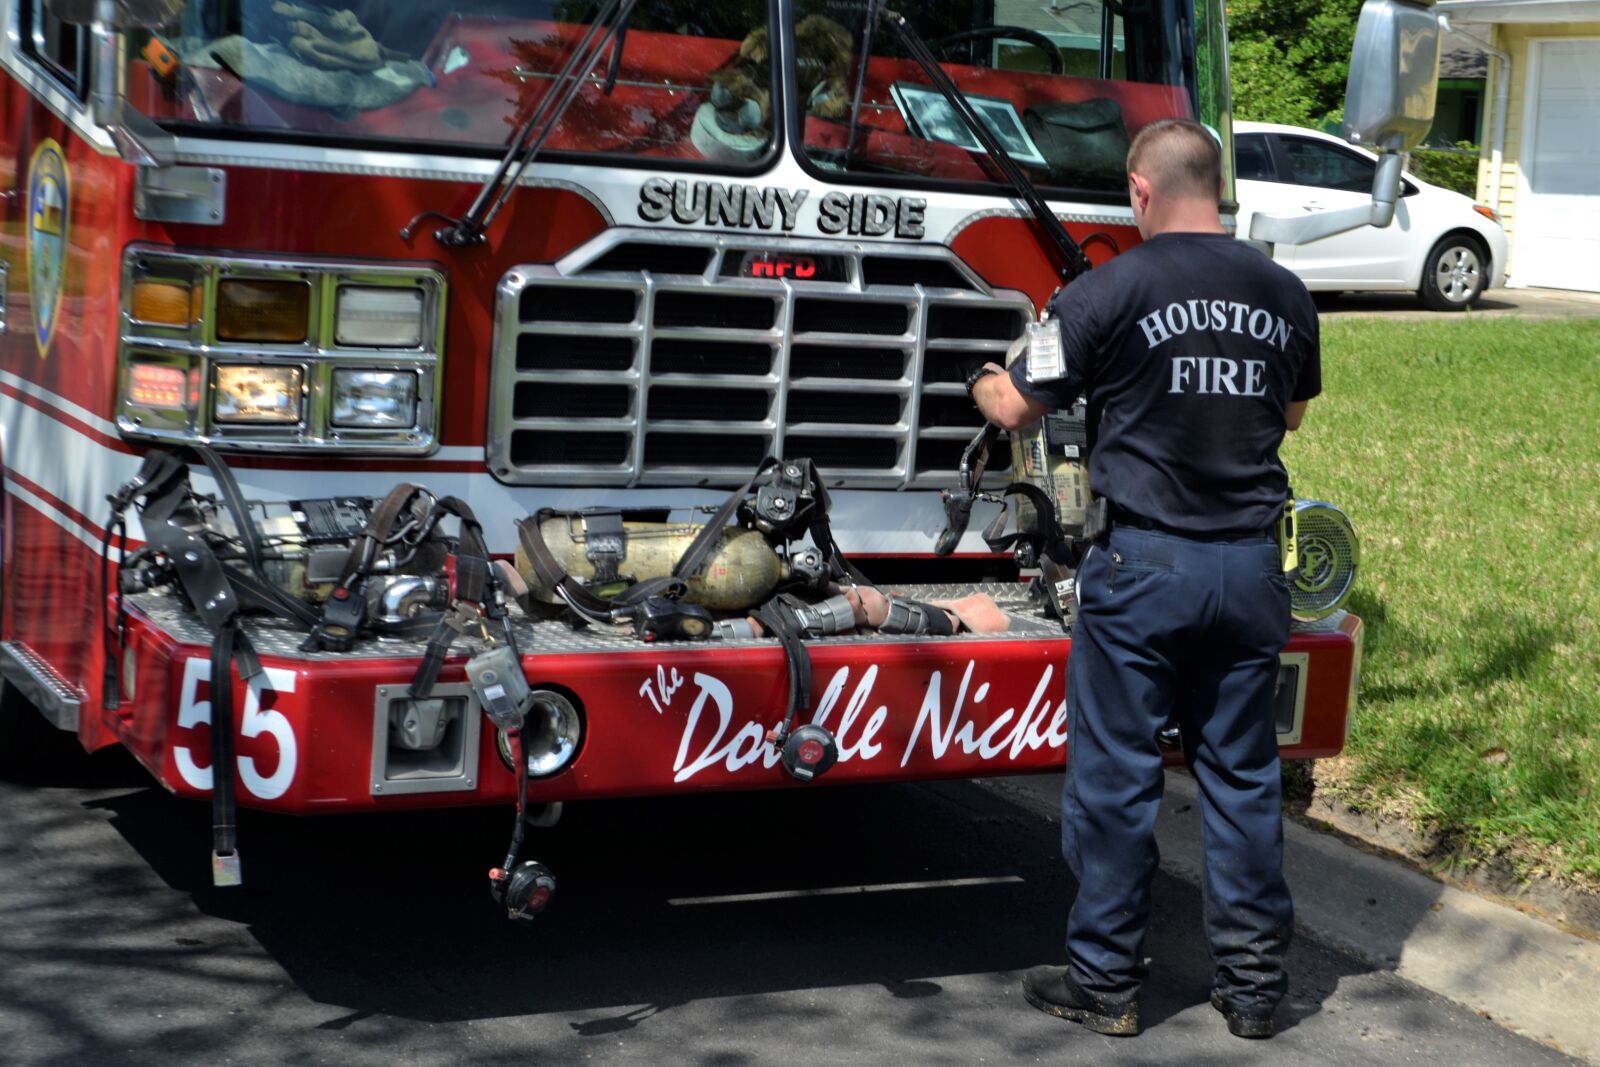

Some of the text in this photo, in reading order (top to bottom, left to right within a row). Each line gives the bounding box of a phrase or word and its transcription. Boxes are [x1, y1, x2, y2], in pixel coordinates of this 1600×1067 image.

[638, 177, 927, 239] SUNNY SIDE
[752, 256, 816, 278] HFD
[1136, 299, 1294, 352] HOUSTON
[1168, 356, 1267, 397] FIRE
[639, 664, 684, 714] The
[173, 656, 297, 800] 55
